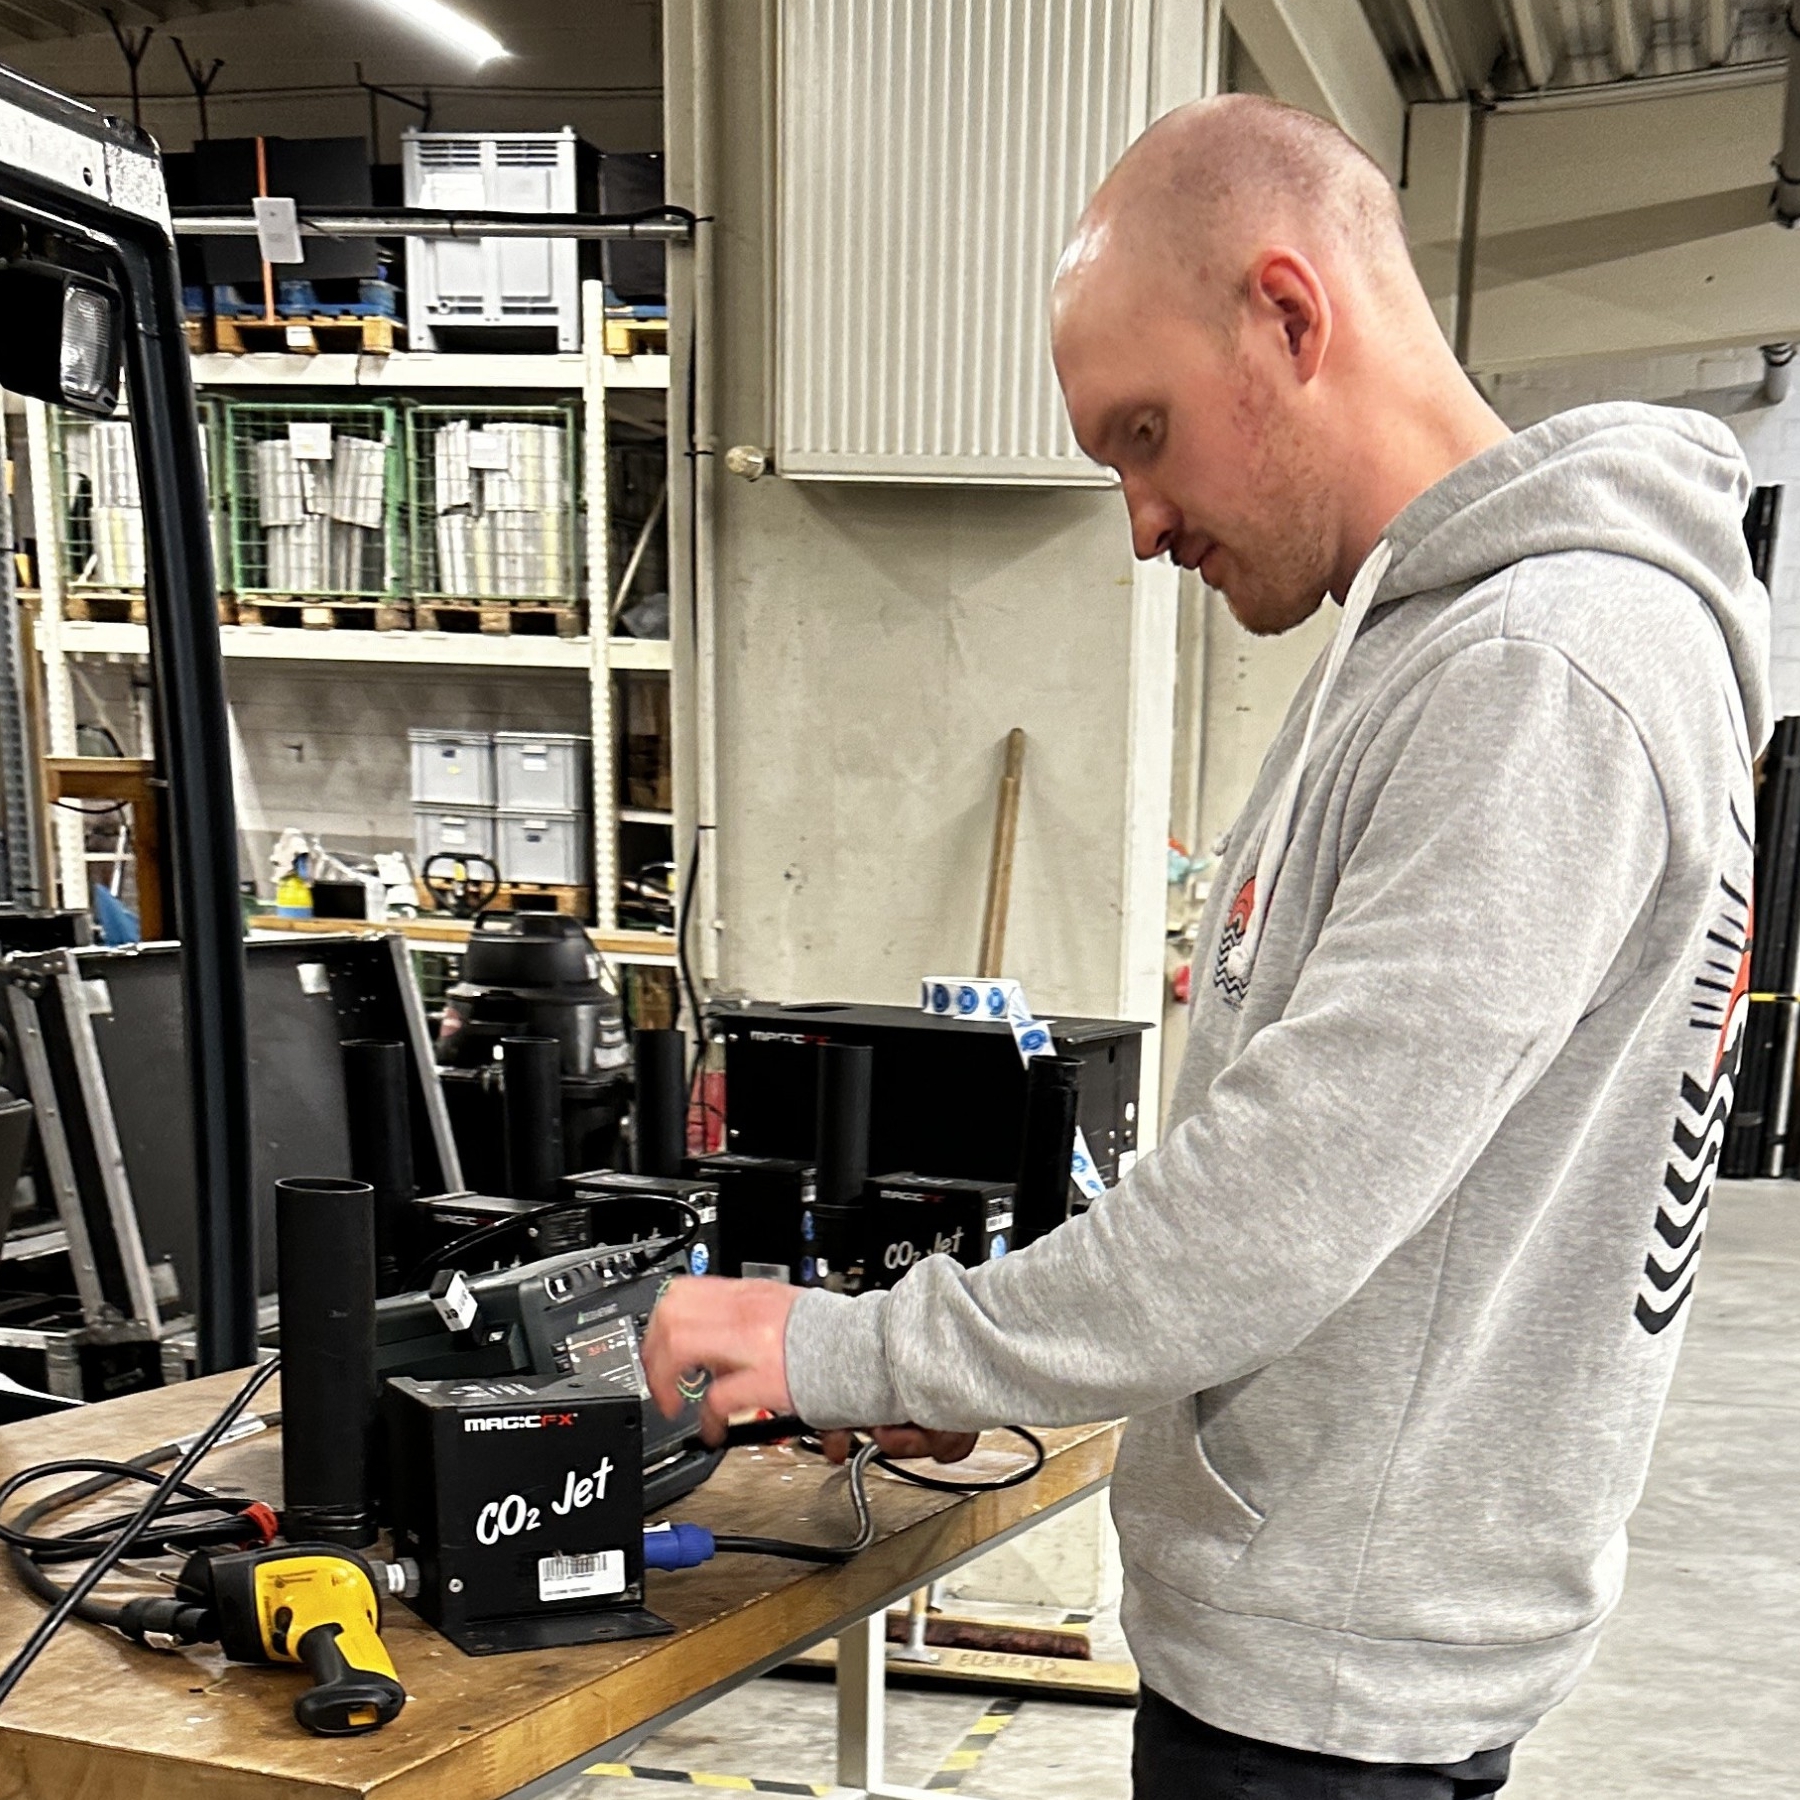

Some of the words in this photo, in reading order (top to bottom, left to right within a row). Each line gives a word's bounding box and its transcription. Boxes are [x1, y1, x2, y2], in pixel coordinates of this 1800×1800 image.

[464, 1413, 575, 1432] MAGICFX
[475, 1494, 542, 1546] CO2
[550, 1456, 614, 1515] Jet
